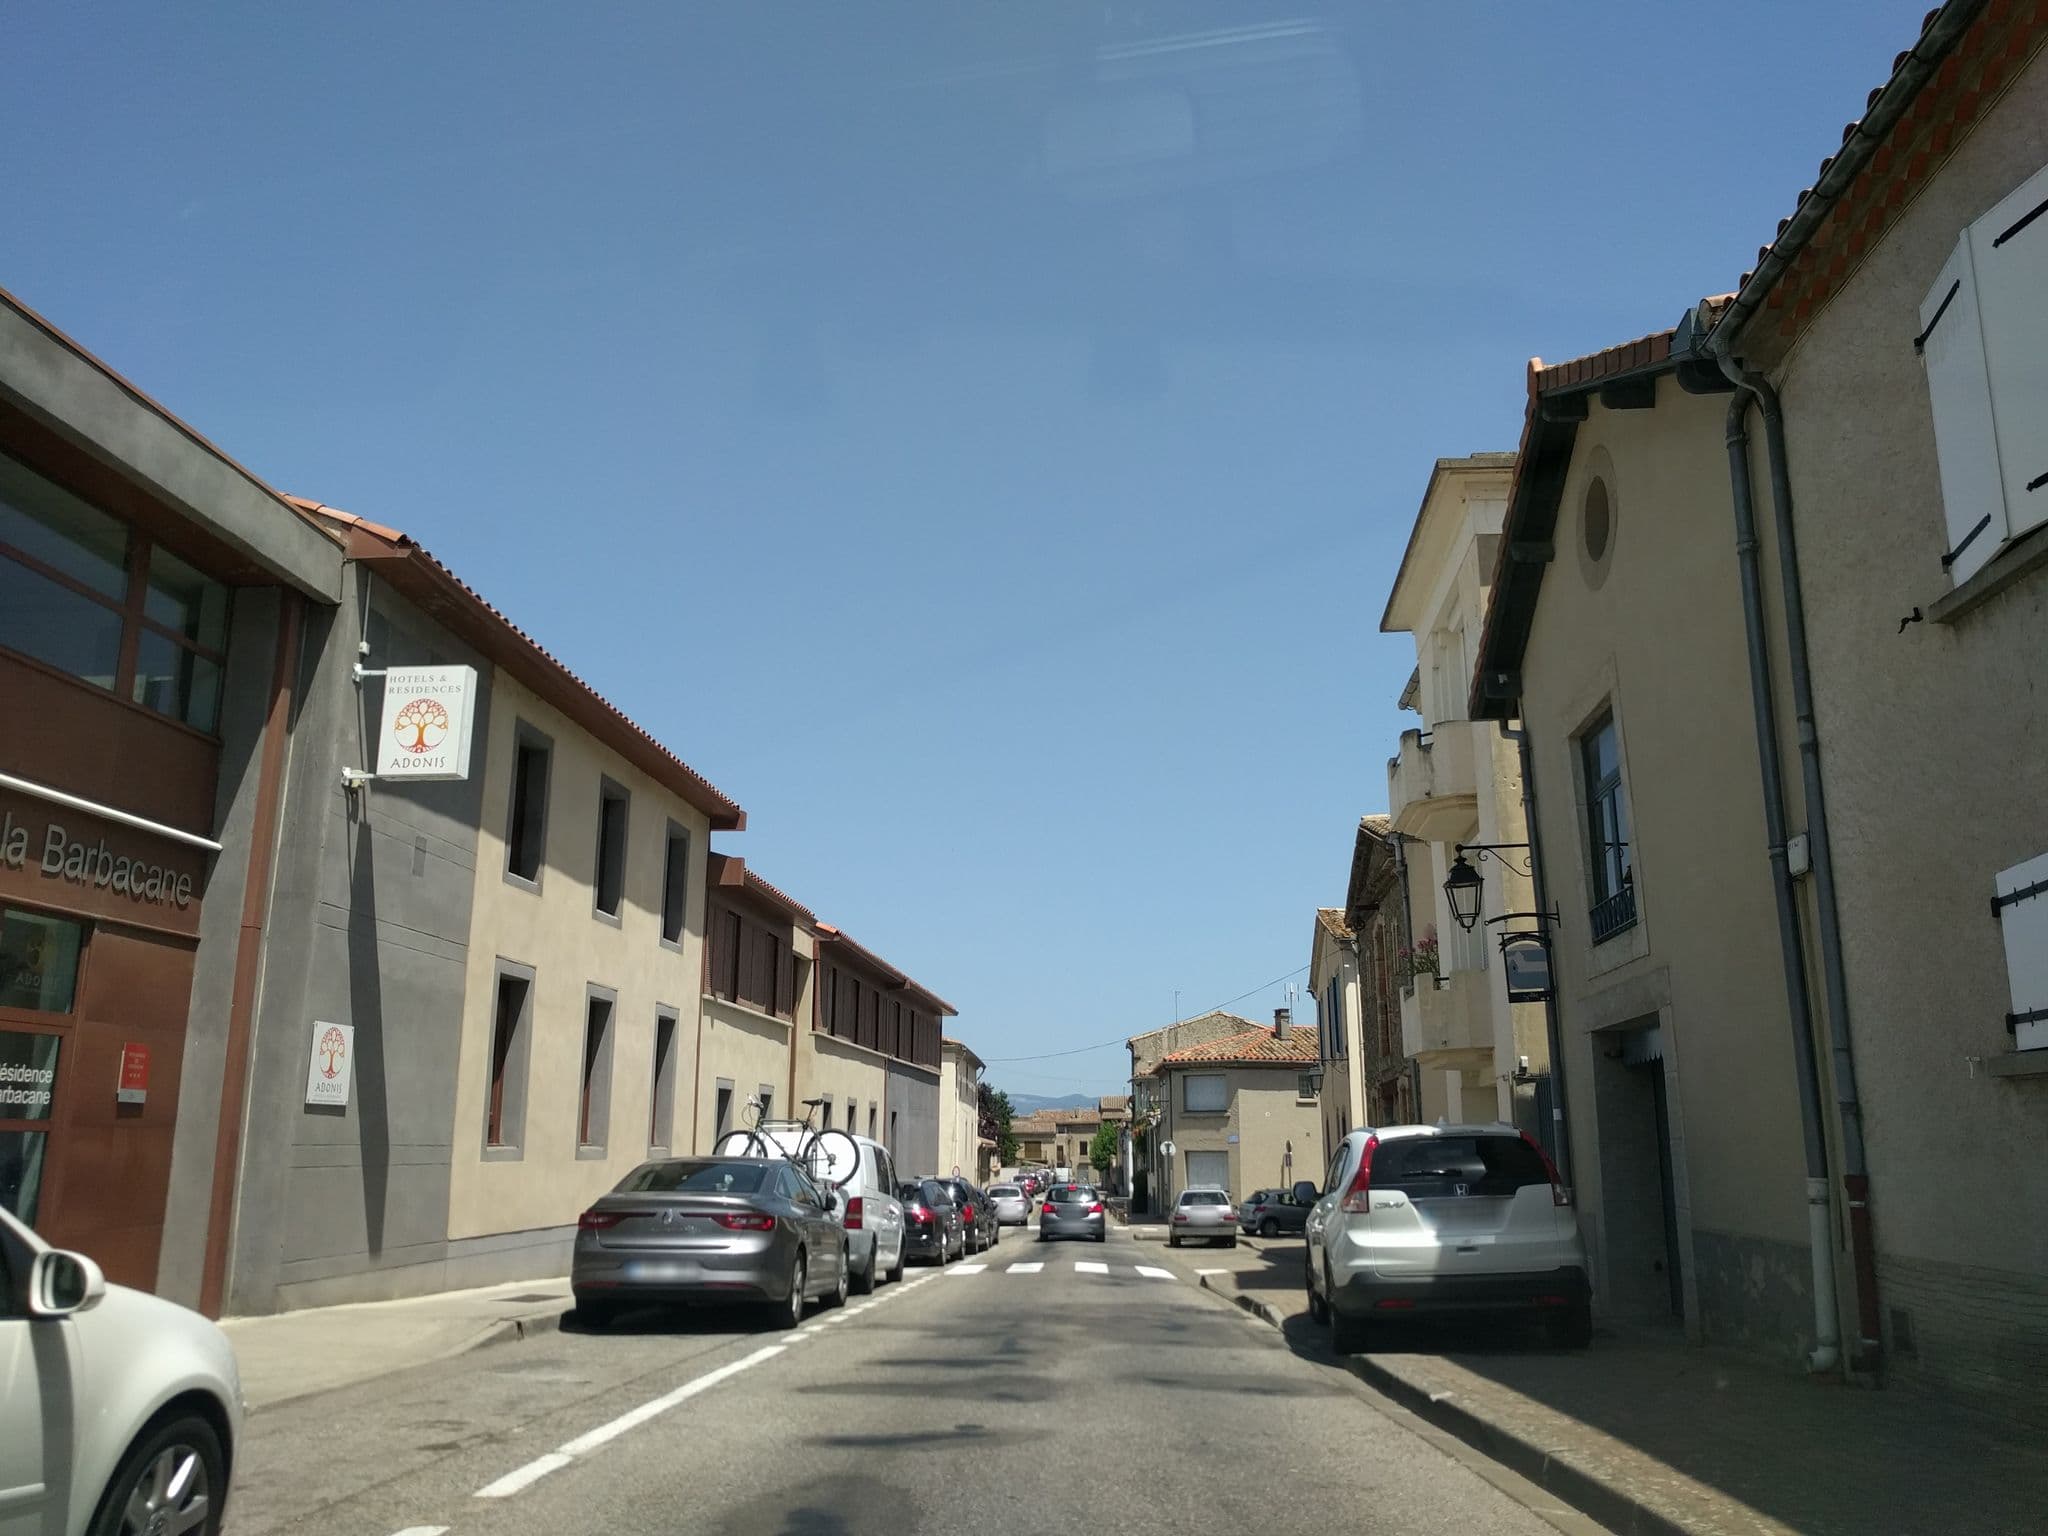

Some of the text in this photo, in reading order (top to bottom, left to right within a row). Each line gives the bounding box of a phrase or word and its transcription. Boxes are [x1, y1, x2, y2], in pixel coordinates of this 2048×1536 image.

[390, 674, 447, 683] HOTELS &
[388, 685, 462, 695] RESIDENCES
[390, 756, 447, 769] ADONIS
[0, 811, 193, 905] la Barbacane
[0, 1063, 53, 1084] ésidence
[314, 1081, 343, 1095] ADONIS
